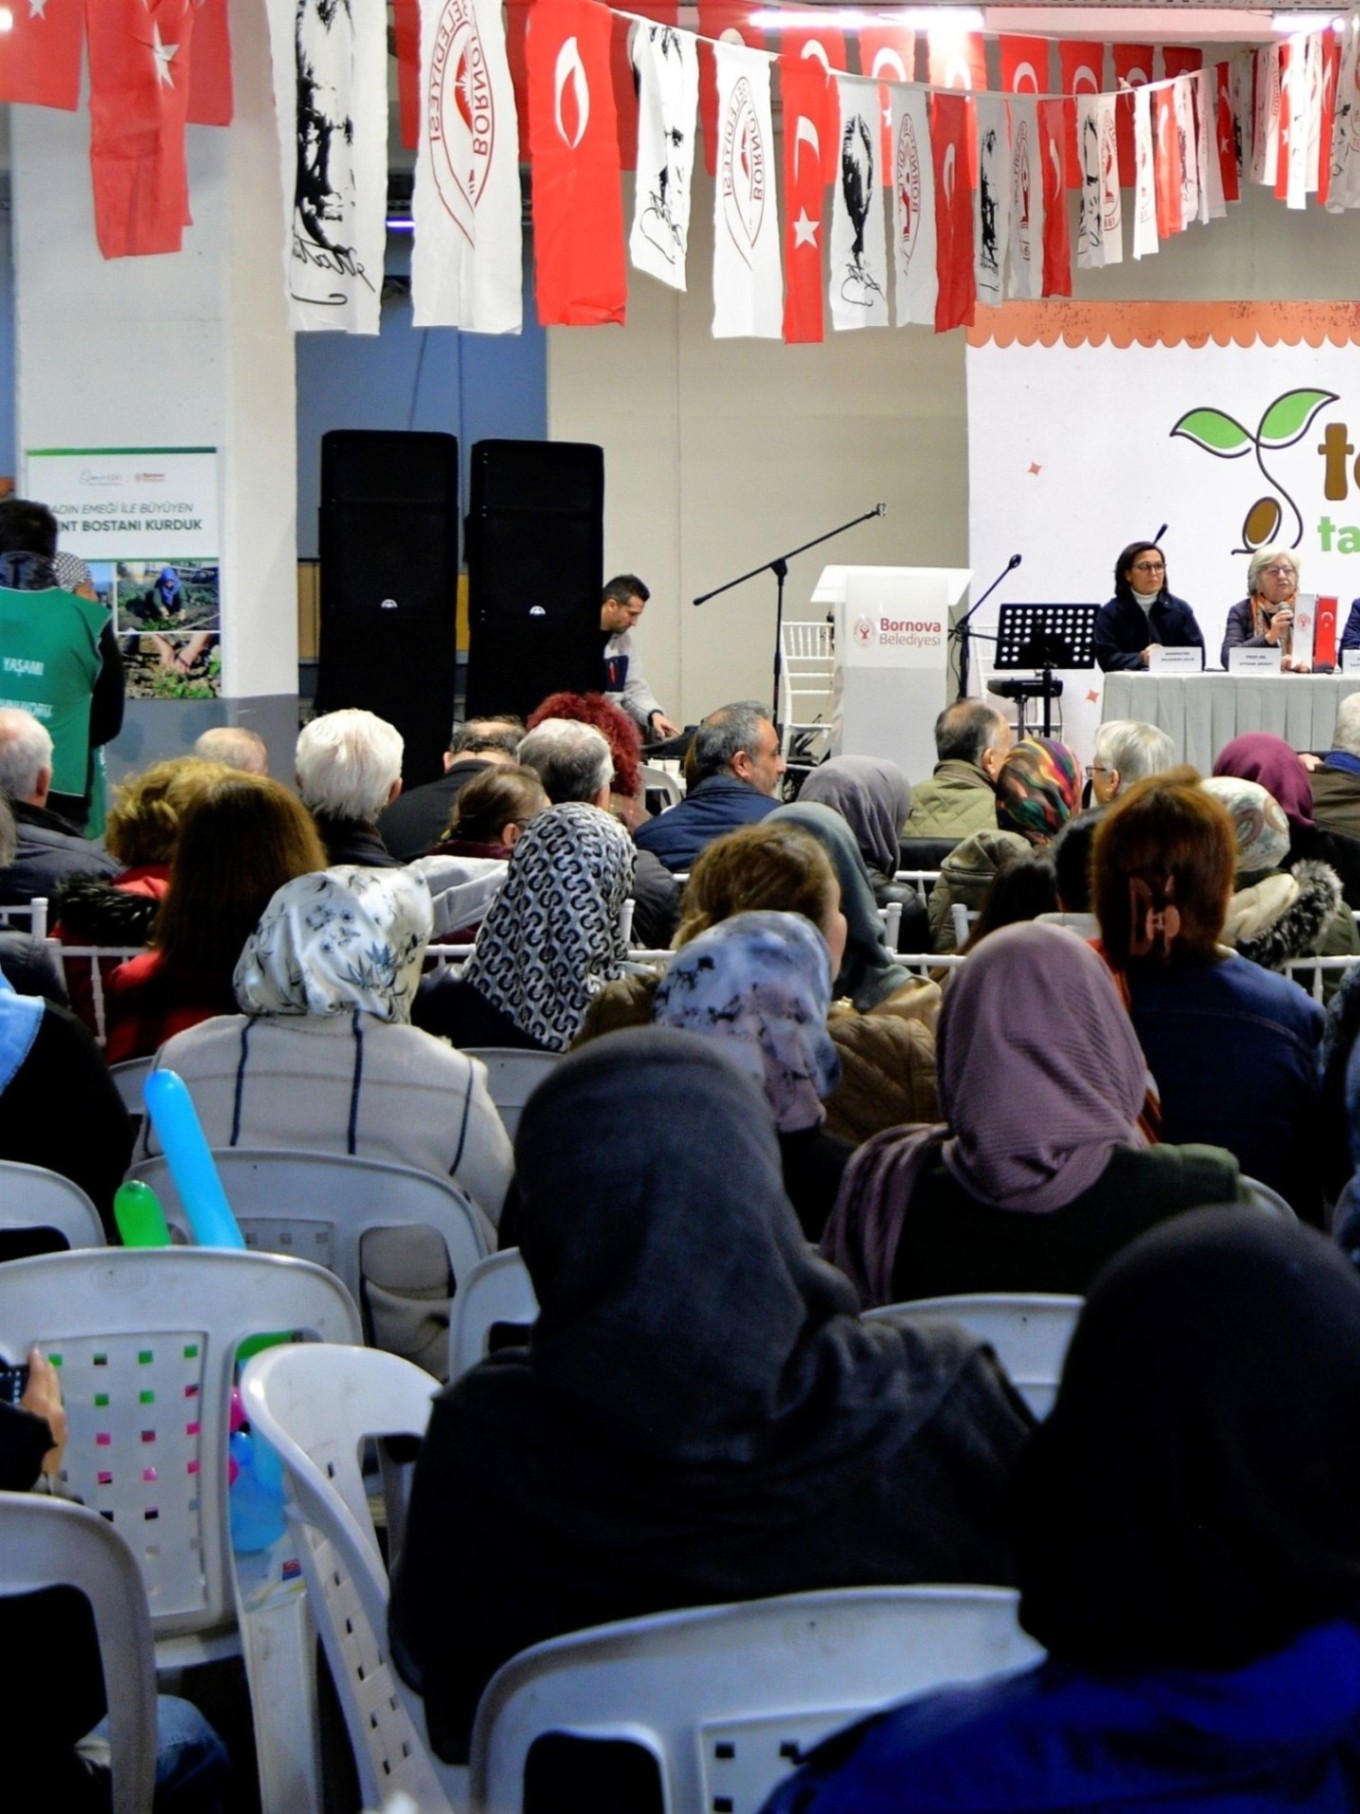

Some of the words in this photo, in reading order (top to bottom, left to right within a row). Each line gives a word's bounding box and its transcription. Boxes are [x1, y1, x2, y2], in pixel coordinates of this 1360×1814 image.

[52, 504, 78, 515] ADIN
[82, 519, 141, 532] BOSTANI
[145, 519, 202, 531] KURDUK
[880, 617, 941, 632] Bornova
[879, 633, 940, 648] Belediyesi
